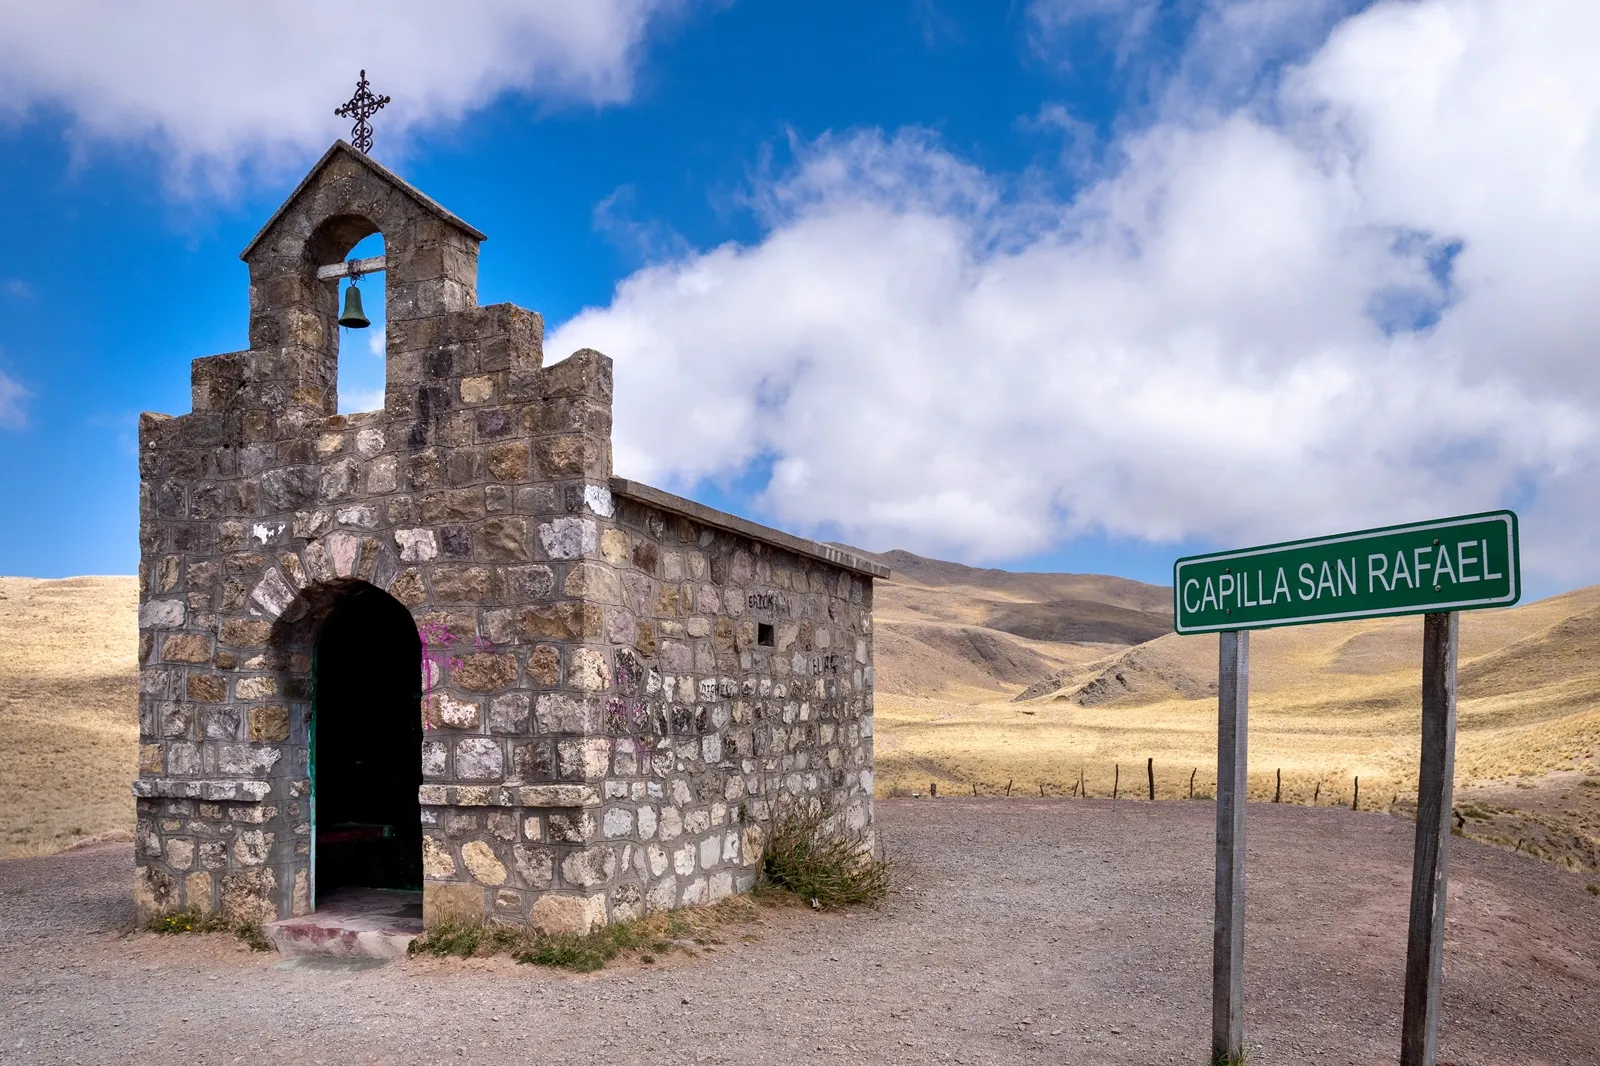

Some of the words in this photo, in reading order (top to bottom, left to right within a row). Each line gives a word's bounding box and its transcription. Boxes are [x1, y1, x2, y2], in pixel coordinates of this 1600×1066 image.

[1184, 567, 1292, 613] CAPILLA
[1298, 557, 1357, 600] SAN
[1368, 539, 1502, 593] RAFAEL
